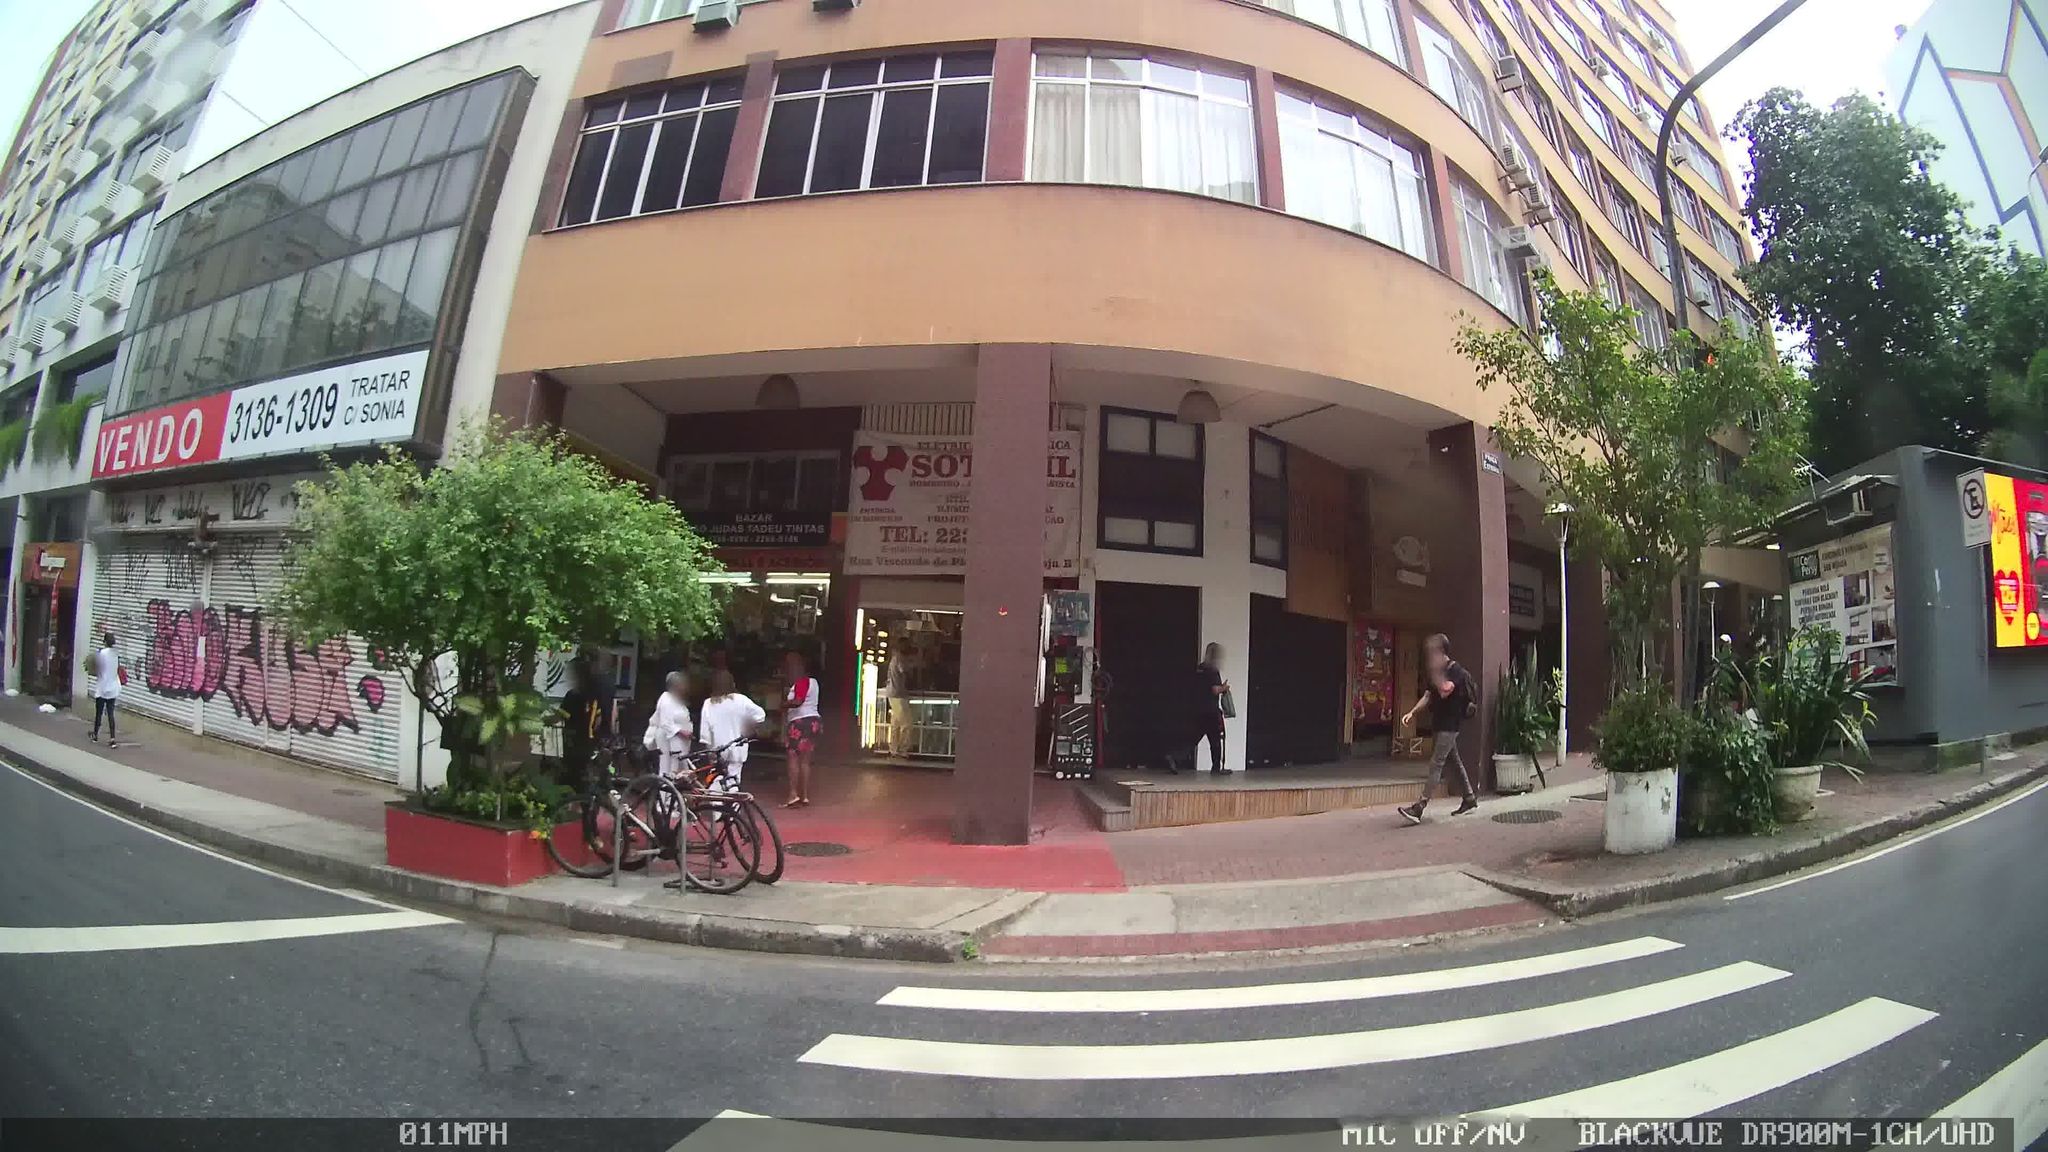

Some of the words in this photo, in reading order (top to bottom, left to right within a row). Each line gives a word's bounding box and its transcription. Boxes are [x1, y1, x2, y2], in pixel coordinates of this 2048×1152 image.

[351, 370, 411, 397] TRATAR
[361, 398, 406, 421] SONIA
[97, 408, 204, 473] VENDO
[230, 382, 339, 443] 3136-1309
[1046, 455, 1076, 479] IL
[735, 513, 773, 523] BAZAR
[747, 524, 783, 534] TADEU
[785, 524, 825, 534] TINTAS
[880, 526, 929, 543] TEL:
